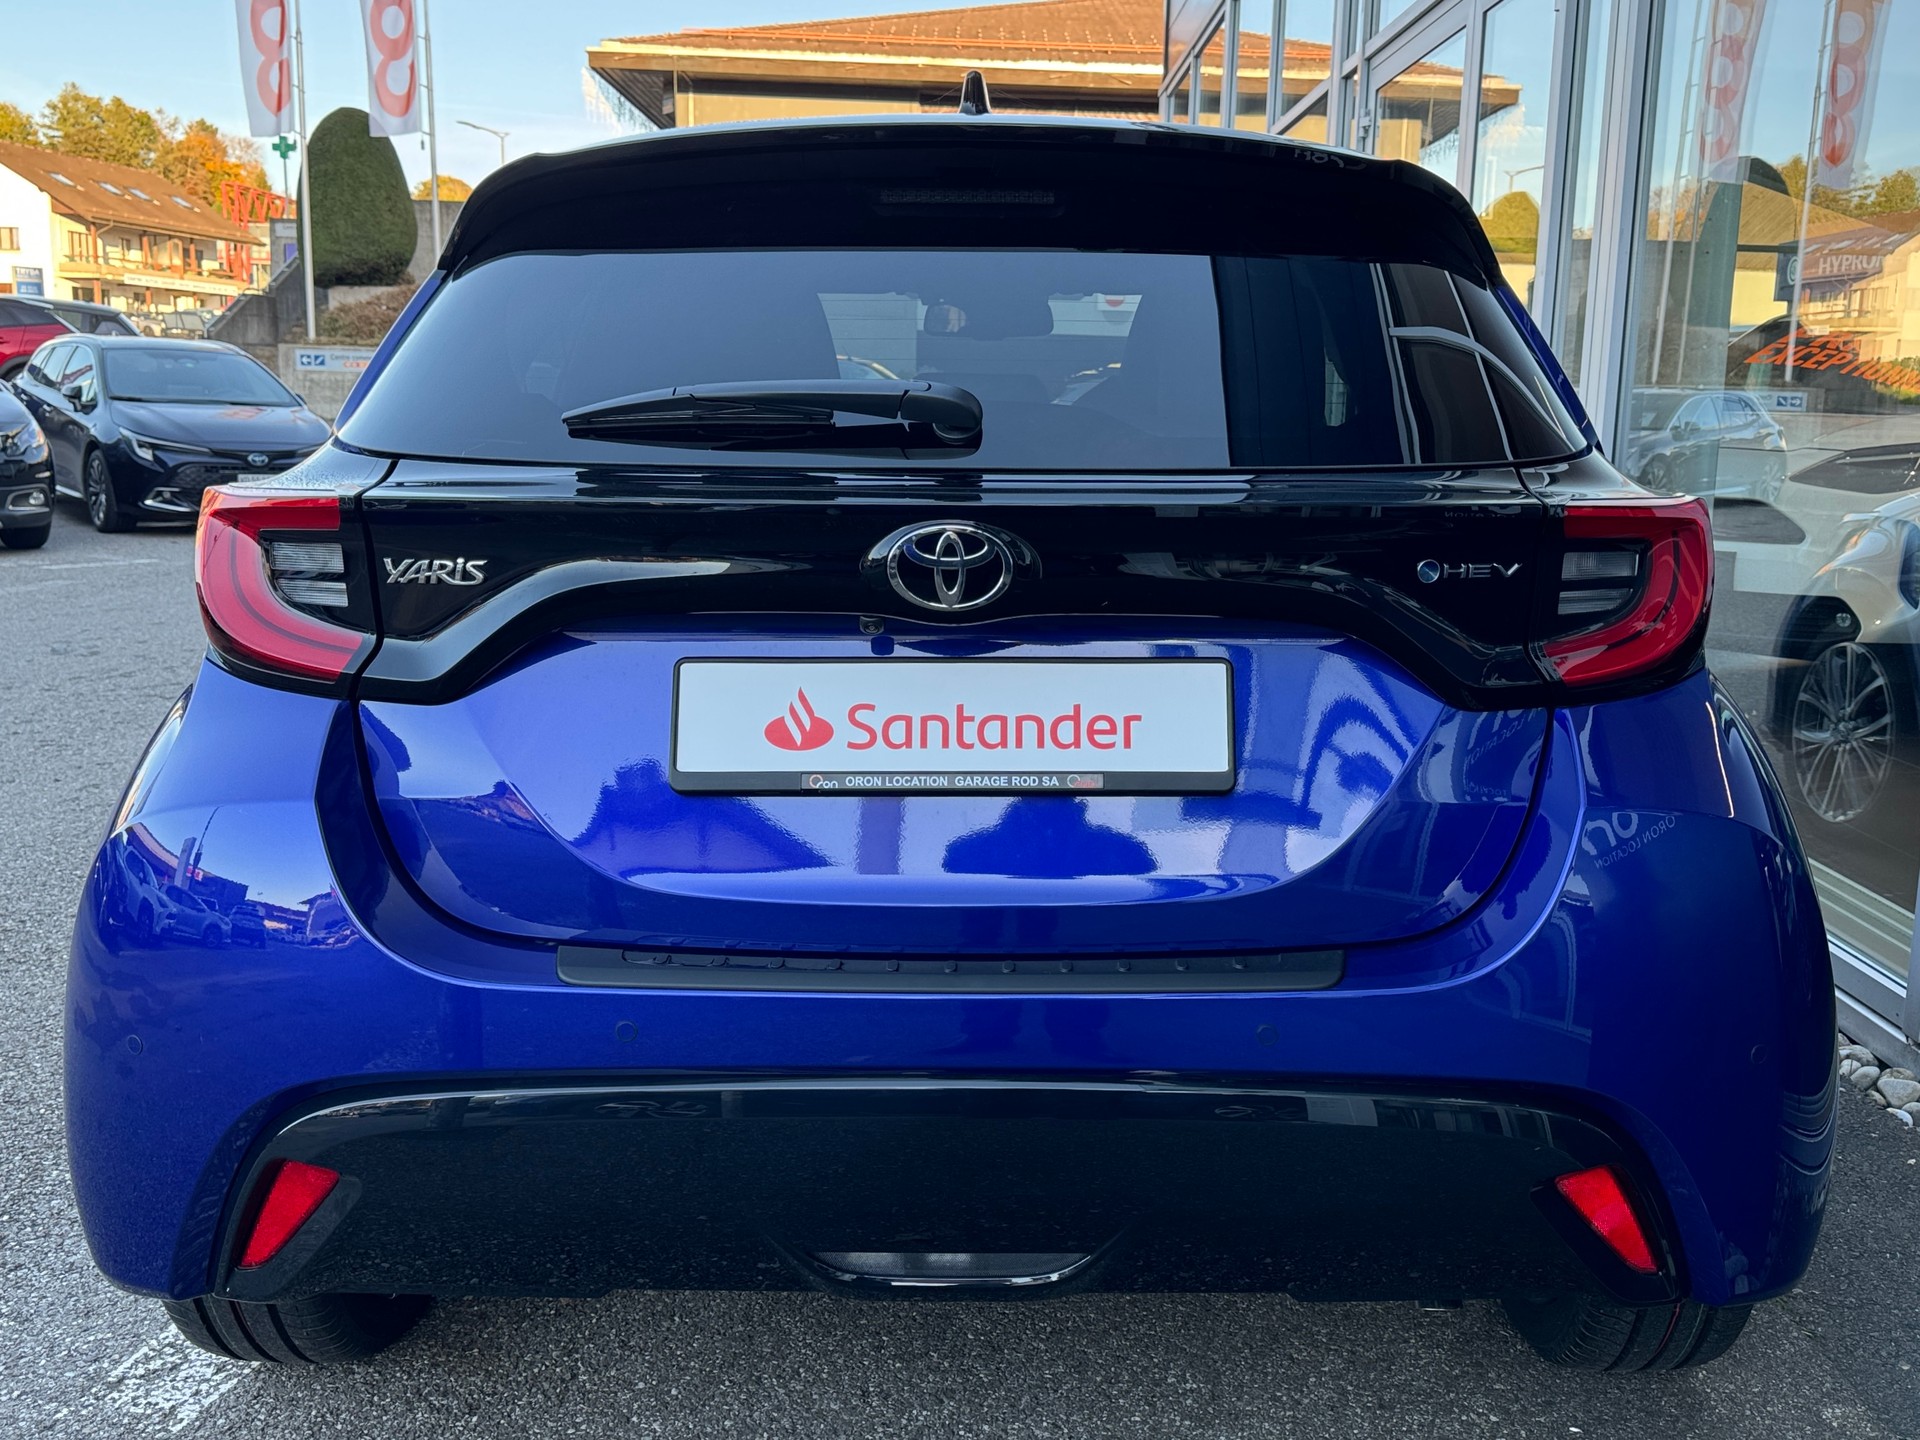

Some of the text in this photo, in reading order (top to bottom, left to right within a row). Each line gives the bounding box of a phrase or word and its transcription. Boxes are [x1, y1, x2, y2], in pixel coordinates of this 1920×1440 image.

[1443, 563, 1523, 578] HEV
[847, 703, 1142, 750] Santander
[845, 776, 882, 787] ORON
[885, 776, 948, 787] LOCATION
[954, 776, 1008, 787] GARAGE
[1011, 776, 1038, 787] ROD
[1042, 776, 1059, 787] SA
